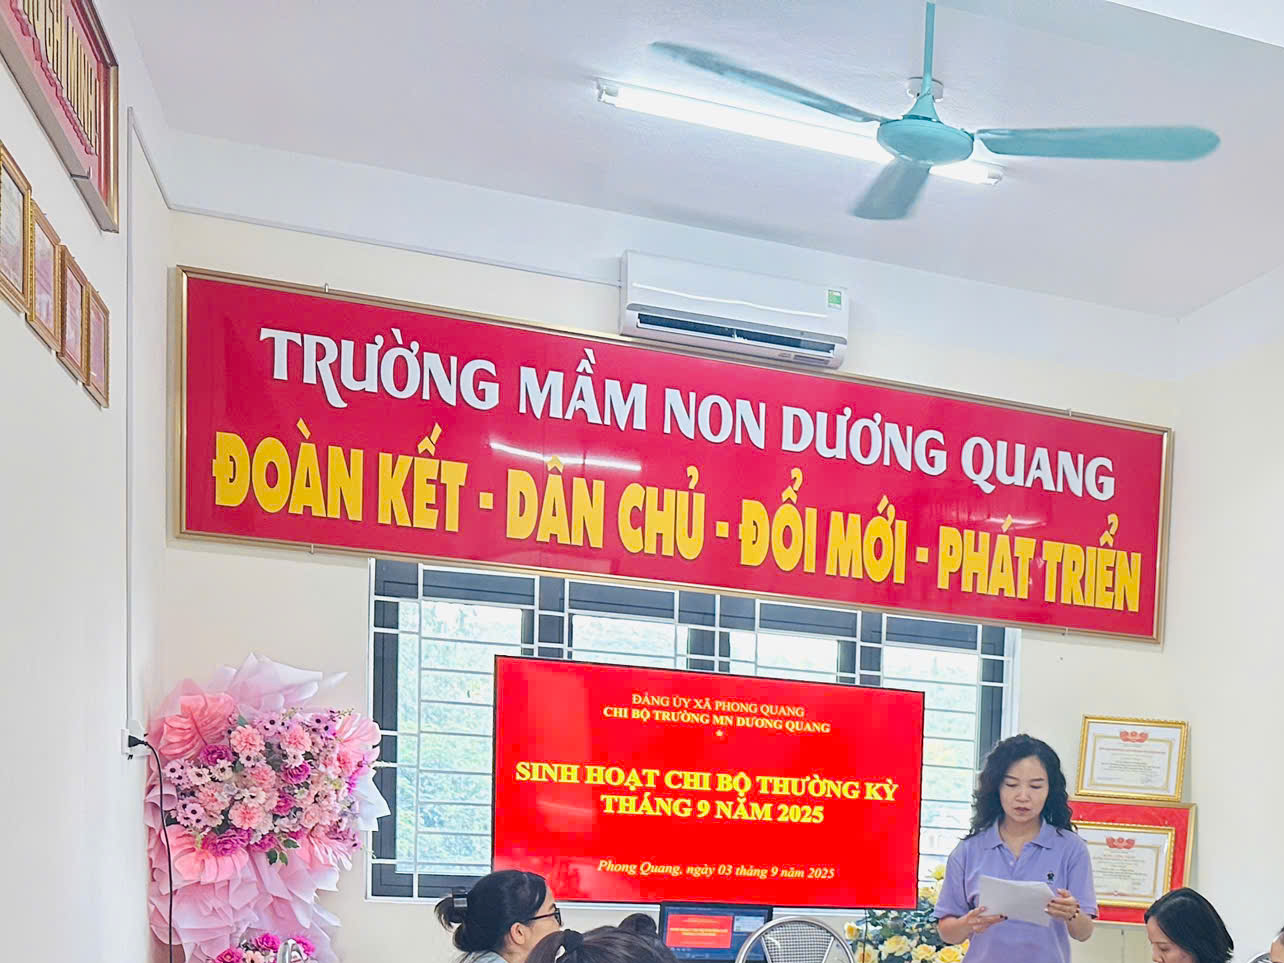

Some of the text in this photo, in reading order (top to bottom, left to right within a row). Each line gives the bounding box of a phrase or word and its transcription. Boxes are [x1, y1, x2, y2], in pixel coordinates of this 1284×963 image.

[259, 327, 1116, 502] TRƯỜNG MẦM NON DƯƠNG QUANG
[213, 417, 364, 522] ĐOÀN
[377, 422, 469, 533] KẾT
[506, 455, 605, 549] DÂN
[617, 465, 706, 561] CHỦ
[738, 467, 818, 574] ĐỔI
[826, 494, 908, 585] MỚI
[937, 513, 1037, 600] PHÁT
[1043, 512, 1142, 613] TRIỂN
[603, 706, 831, 734] CHI BỘ TRƯỜNG MN DƯƠNG QUANG
[631, 692, 670, 707] ĐẢNG
[693, 697, 713, 710] XÃ
[714, 699, 758, 714] PHONG
[759, 704, 805, 718] QUANG
[515, 761, 899, 801] SINH HOẠT CHI BỘ THƯỜNG KỲ
[600, 791, 825, 824] THÁNG 9 NĂM 2025
[597, 860, 637, 875] Phong
[685, 864, 716, 877] ngày
[717, 864, 733, 876] 03
[735, 864, 768, 880] tháng
[770, 866, 779, 878] 9
[780, 867, 805, 878] năm
[807, 867, 836, 879] 2025
